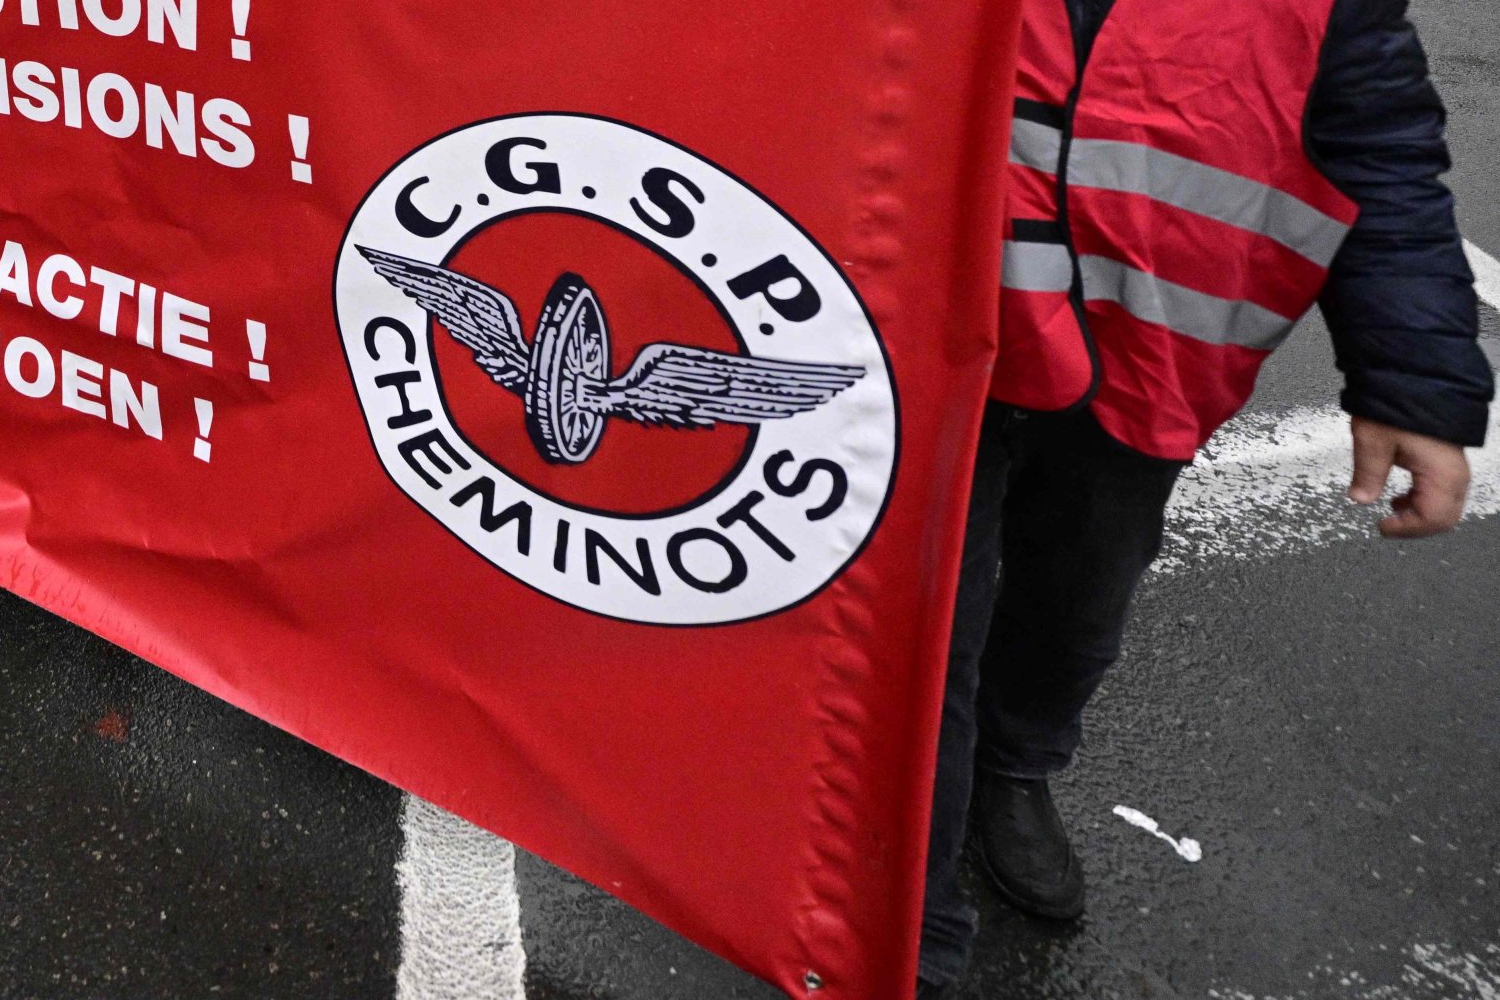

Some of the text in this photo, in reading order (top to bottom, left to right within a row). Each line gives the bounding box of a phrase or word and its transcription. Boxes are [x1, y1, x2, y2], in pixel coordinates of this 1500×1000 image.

[287, 112, 313, 185] !
[245, 317, 271, 383] !
[192, 396, 214, 463] !
[363, 315, 848, 597] CHEMINOTS
